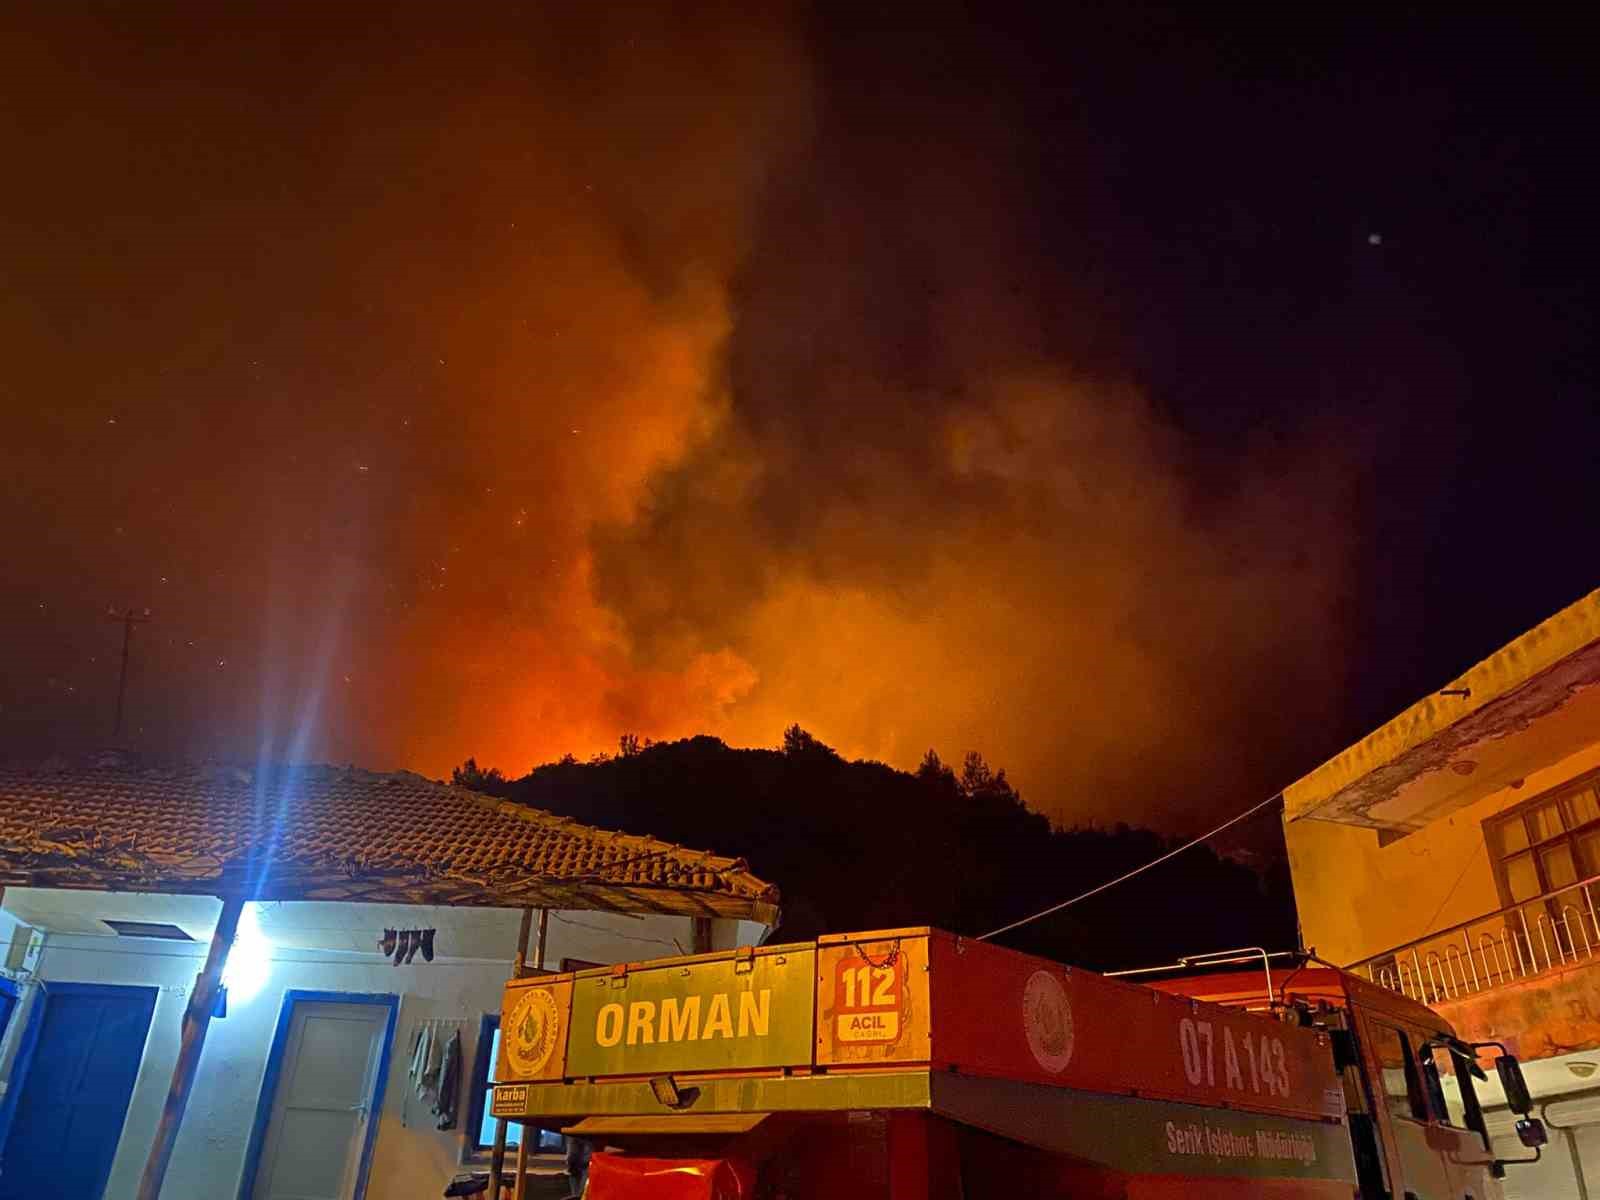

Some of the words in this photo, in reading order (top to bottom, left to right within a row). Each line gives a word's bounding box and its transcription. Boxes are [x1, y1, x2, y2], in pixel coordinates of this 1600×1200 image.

[843, 966, 896, 1007] 112
[596, 989, 771, 1047] ORMAN
[1179, 1018, 1215, 1087] 07
[1224, 1025, 1244, 1090] A
[1243, 1031, 1290, 1098] 143
[496, 1087, 526, 1101] karba
[1166, 1121, 1204, 1155] Serik
